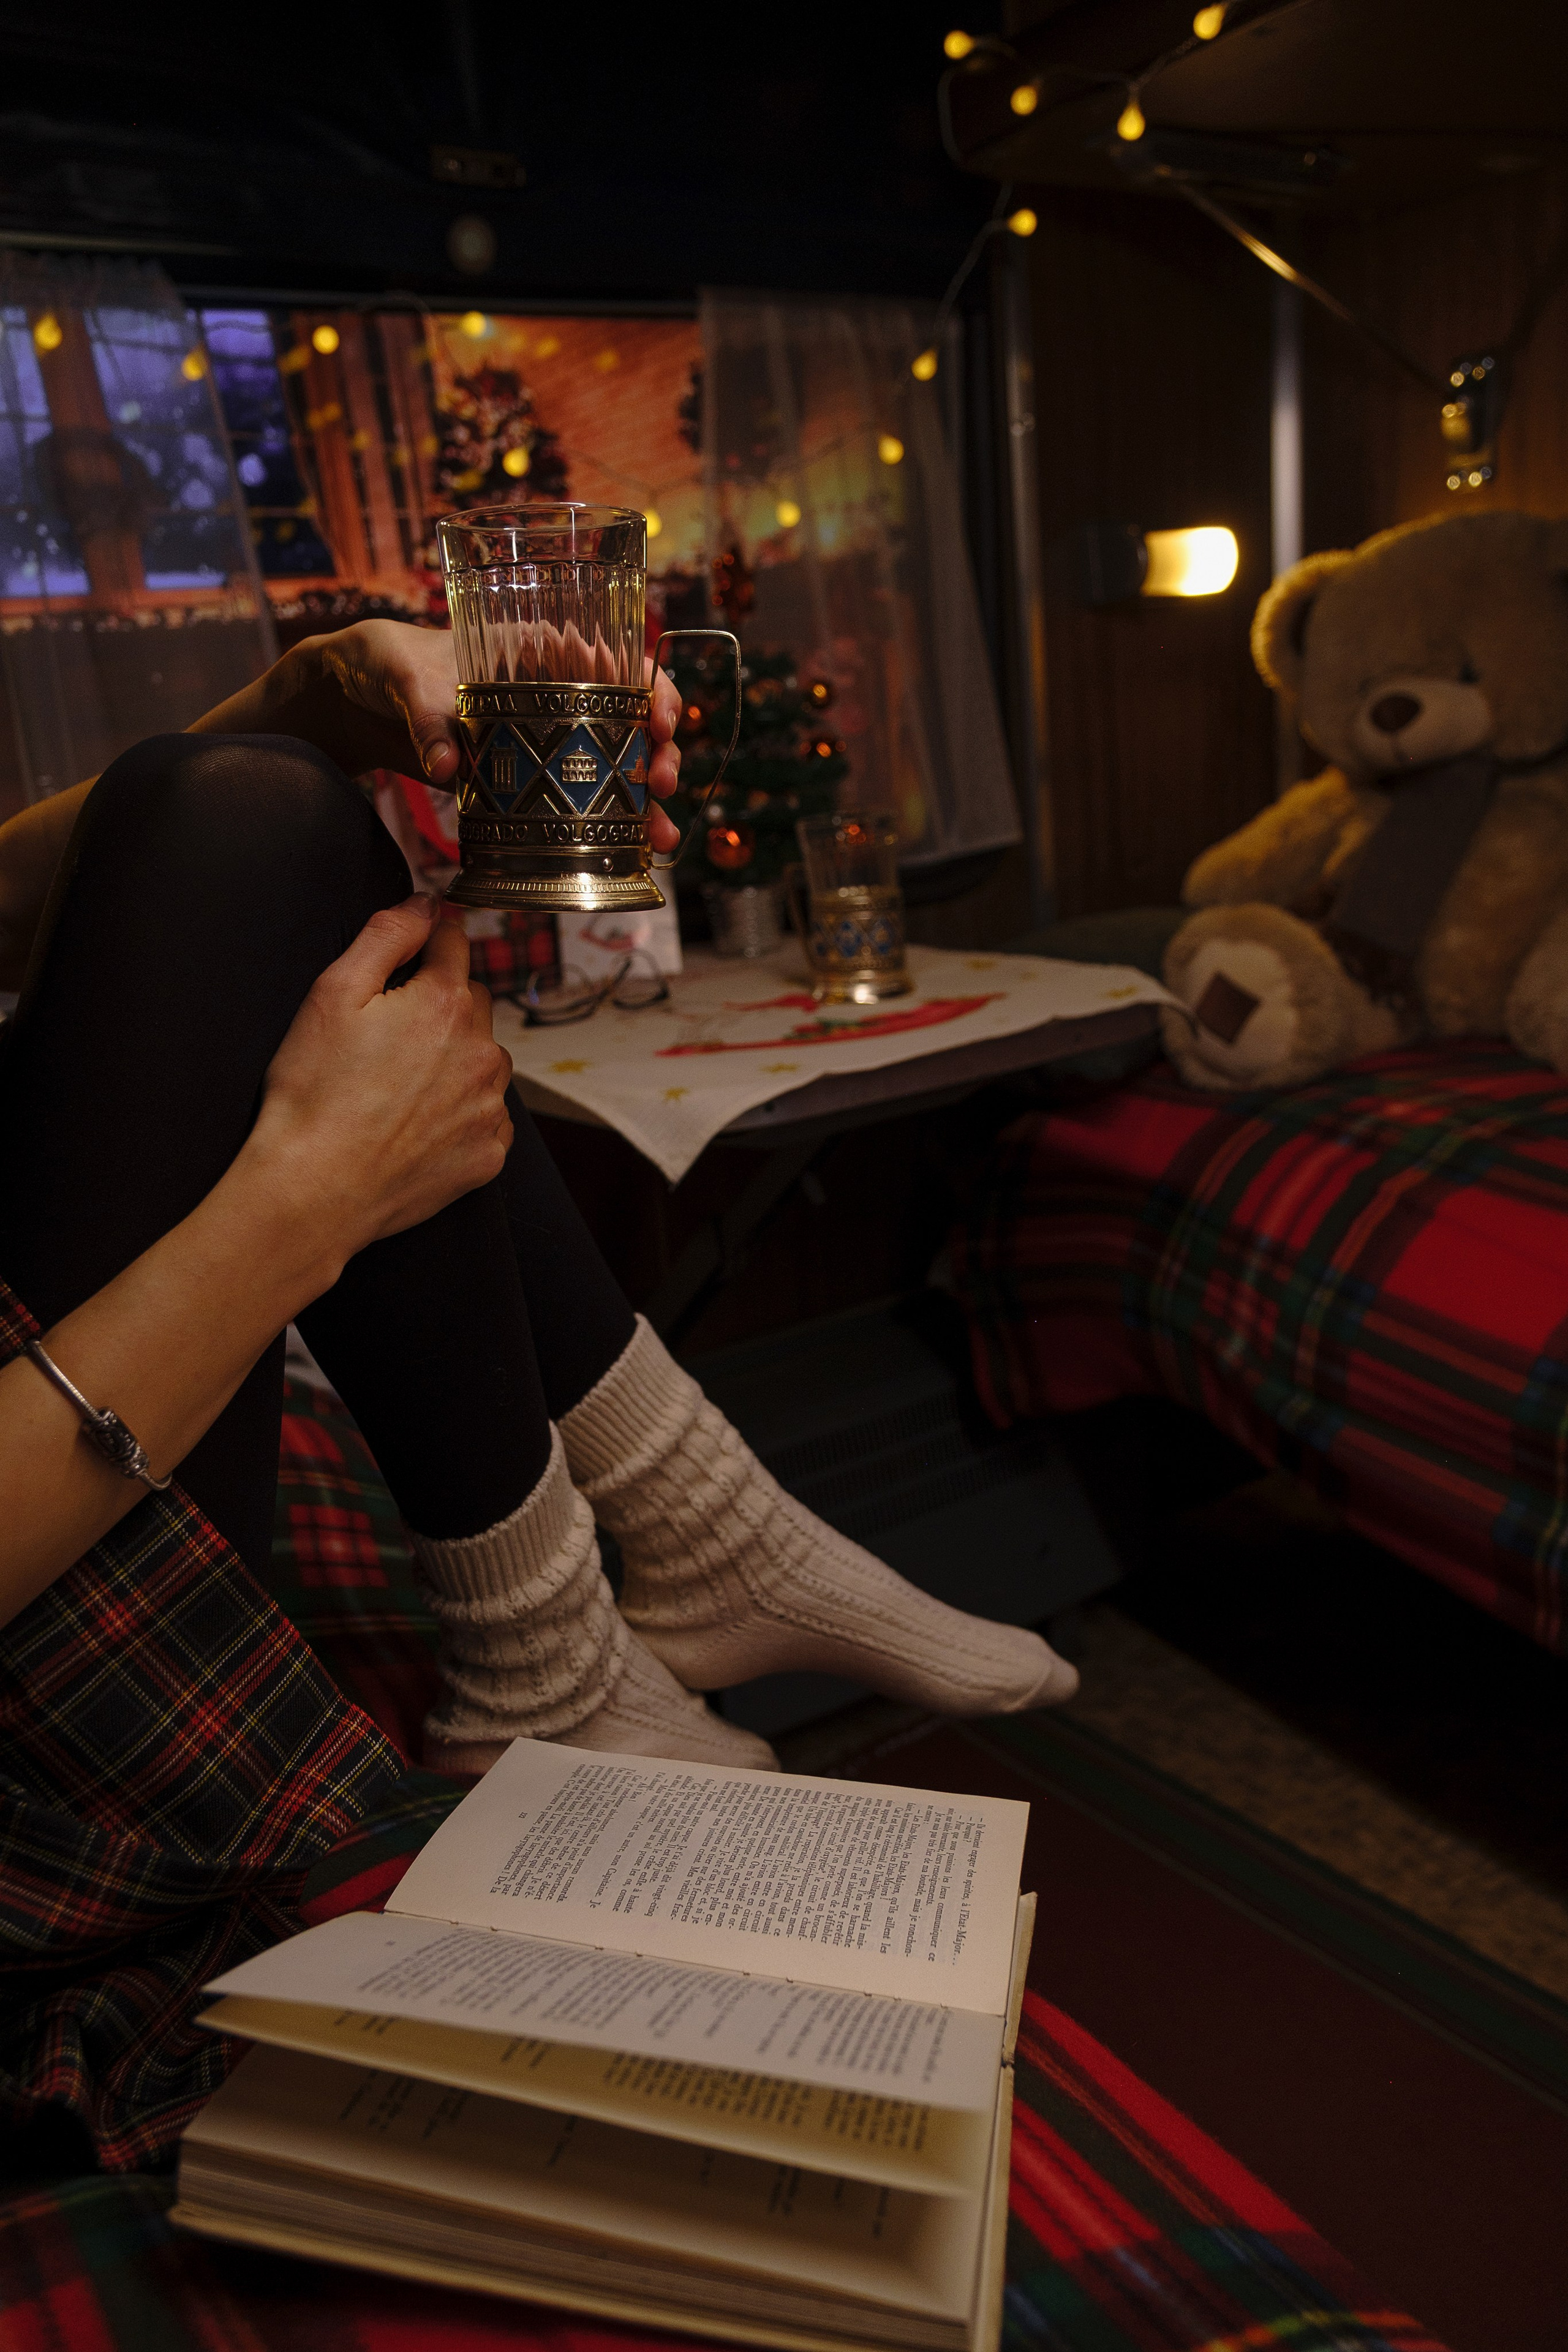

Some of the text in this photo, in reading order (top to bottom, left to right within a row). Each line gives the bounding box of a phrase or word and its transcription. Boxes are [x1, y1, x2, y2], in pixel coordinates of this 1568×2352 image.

[504, 1834, 535, 1870] laryngophones
[534, 1841, 551, 1859] miracle
[556, 1845, 570, 1861] même
[568, 1847, 580, 1861] point
[508, 1842, 540, 1881] laryngophones,
[571, 1858, 585, 1874] aucun
[644, 1855, 656, 1869] crâne
[665, 1861, 679, 1872] déjà
[512, 1869, 533, 1896] changera
[636, 1872, 647, 1886] enfle
[714, 1877, 730, 1894] lourd,
[730, 1872, 741, 1887] entre
[750, 1880, 761, 1896] entre
[533, 1881, 551, 1900] désert
[677, 1880, 692, 1901] vieilles
[703, 1883, 716, 1896] bloc
[736, 1883, 750, 1902] ajouté
[762, 1881, 772, 1896] entre
[783, 1883, 795, 1903] prends
[807, 1885, 821, 1903] circuit
[820, 1880, 831, 1901] comme
[842, 1882, 858, 1908] laborieux
[612, 1889, 627, 1912] comme
[624, 1895, 639, 1913] haute
[644, 1885, 666, 1917] vingt-cinq
[680, 1888, 701, 1922] fermetures
[709, 1897, 721, 1910] plus
[767, 1902, 778, 1915] tout
[791, 1899, 802, 1915] entre
[913, 1898, 922, 1912] mais
[739, 1909, 753, 1931] circuit
[777, 1906, 790, 1922] dans
[862, 1902, 873, 1922] quand
[750, 1910, 764, 1933] circuit
[761, 1917, 772, 1934] aussi
[883, 1917, 895, 1939] aillent
[930, 1902, 944, 1948] communiquer
[832, 1921, 843, 1946] revêtir
[844, 1915, 861, 1948] harnache
